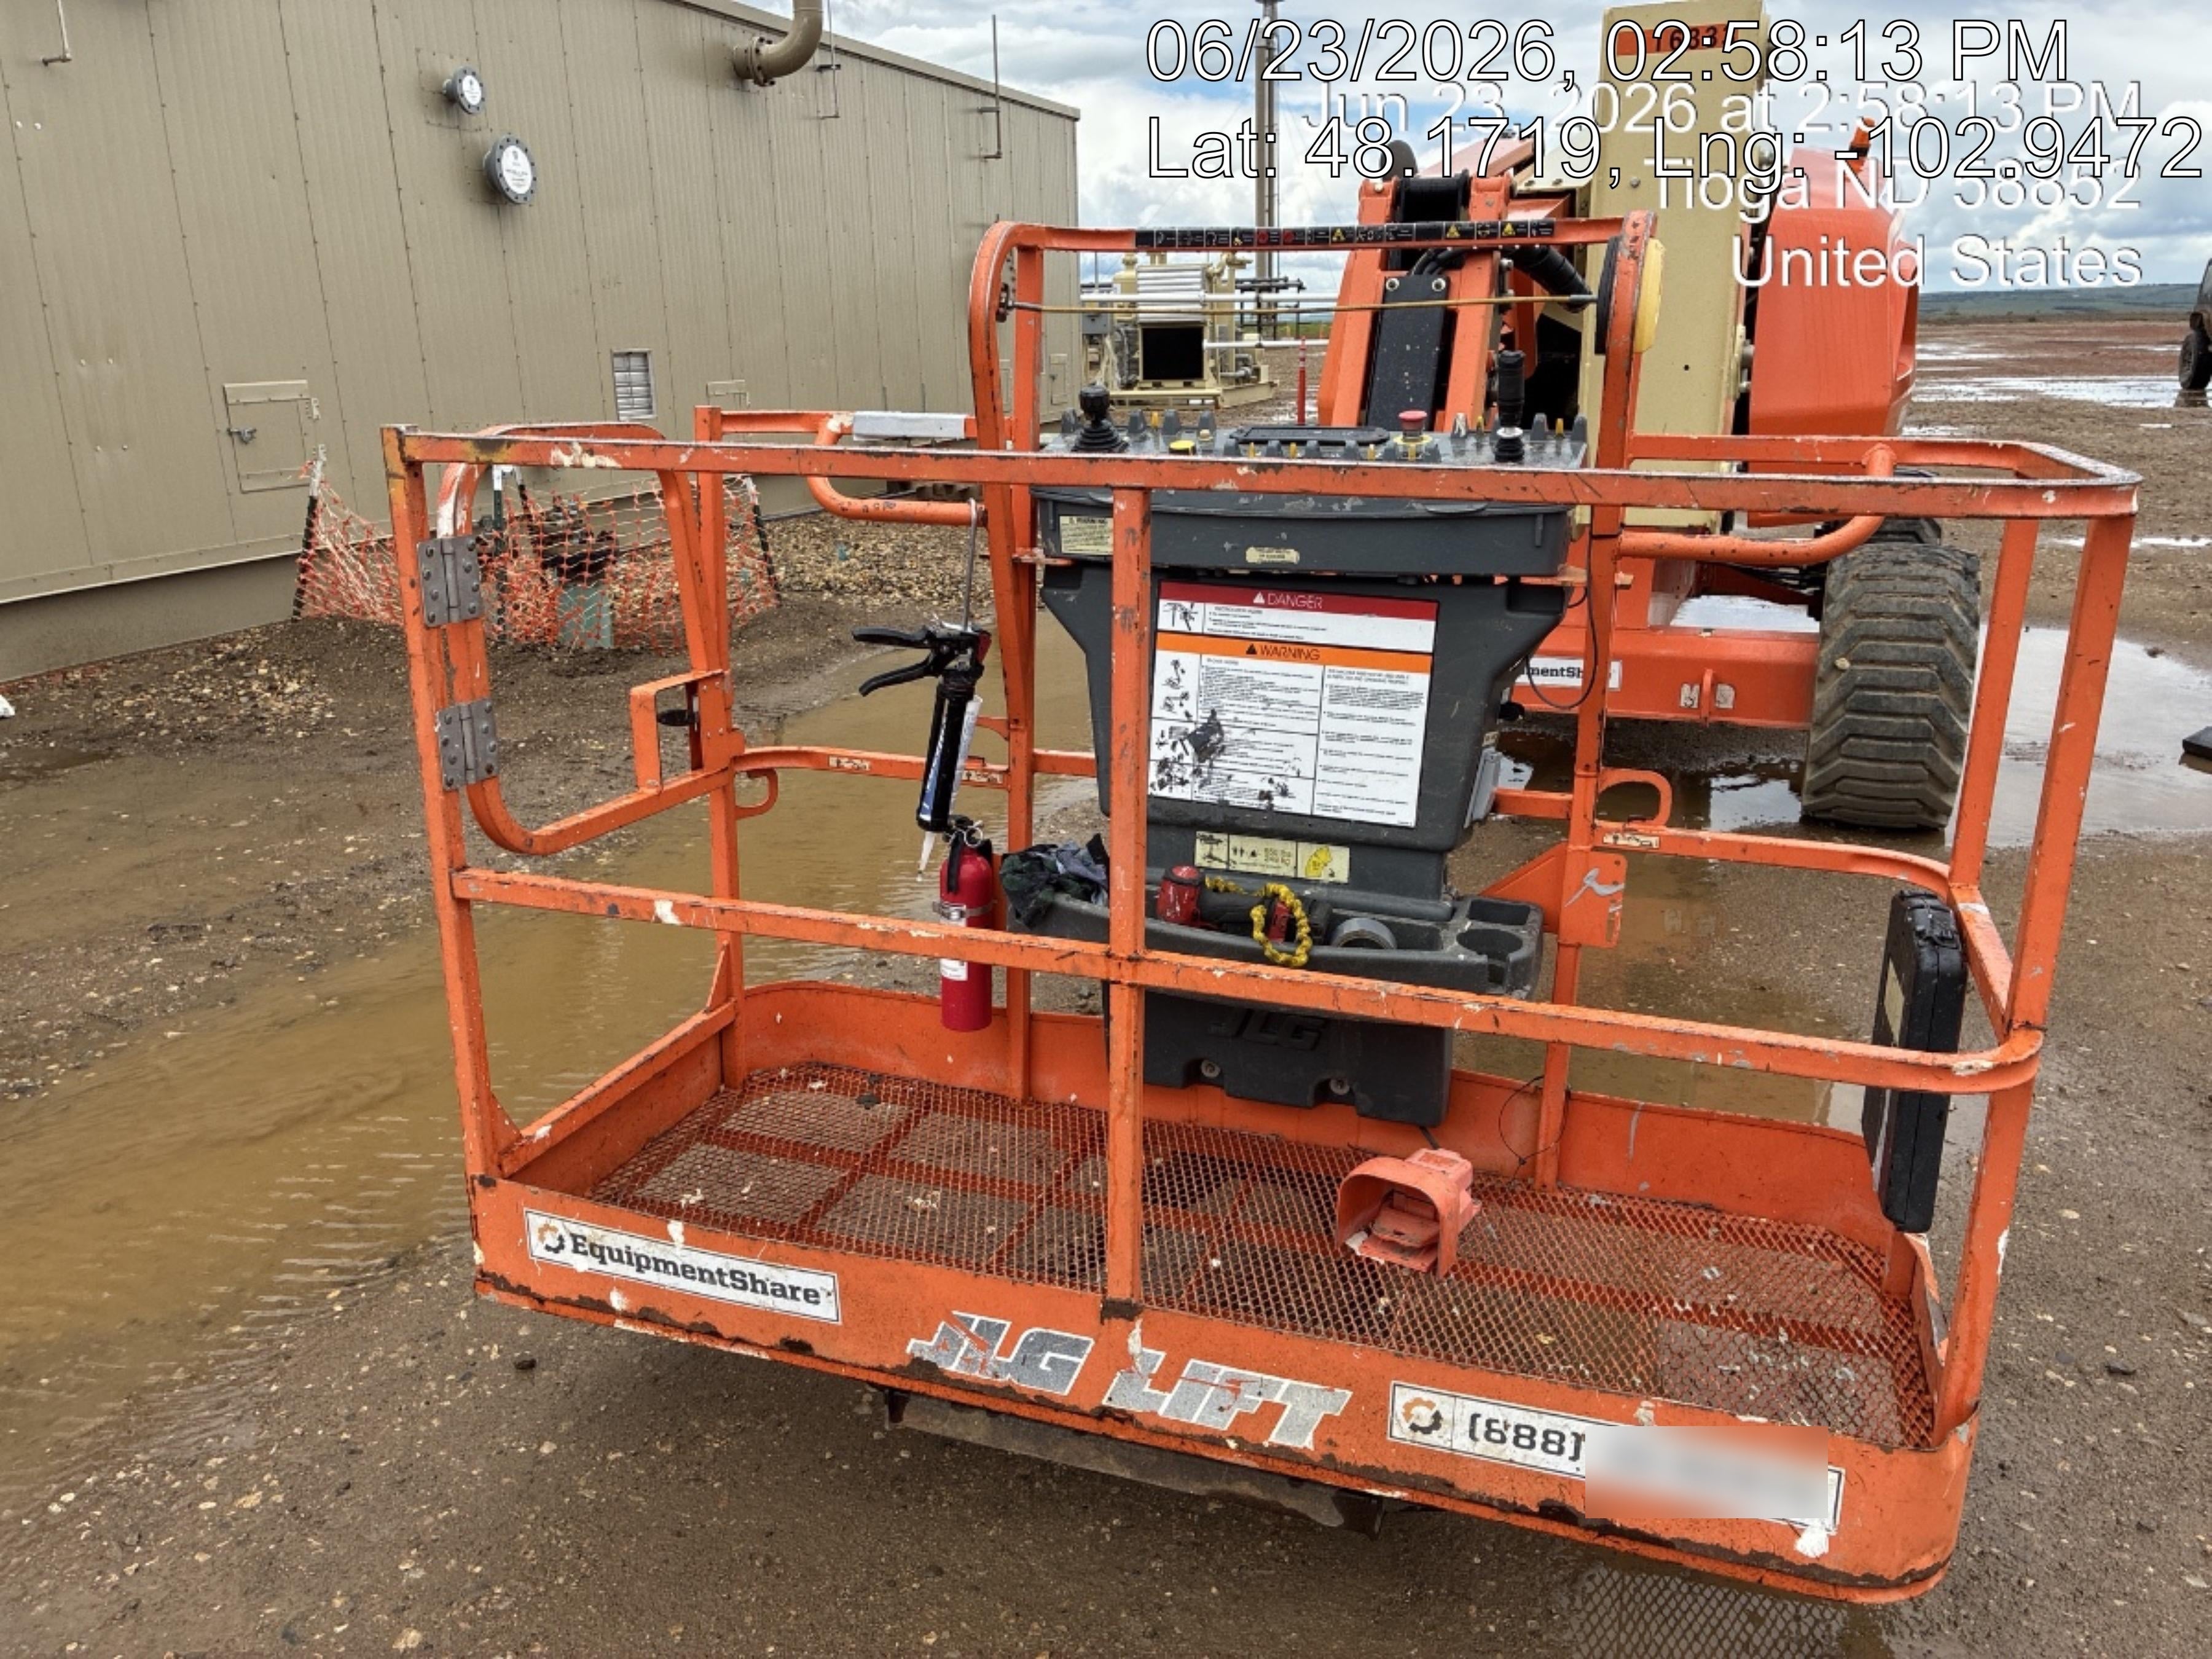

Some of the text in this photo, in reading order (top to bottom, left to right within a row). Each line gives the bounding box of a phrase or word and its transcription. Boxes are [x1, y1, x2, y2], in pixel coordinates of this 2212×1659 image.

[1268, 593, 1324, 608] DANGER
[1260, 645, 1321, 661] WARNING
[570, 1233, 822, 1306] EquipmentShare
[906, 1310, 1354, 1451] JLG LIFT
